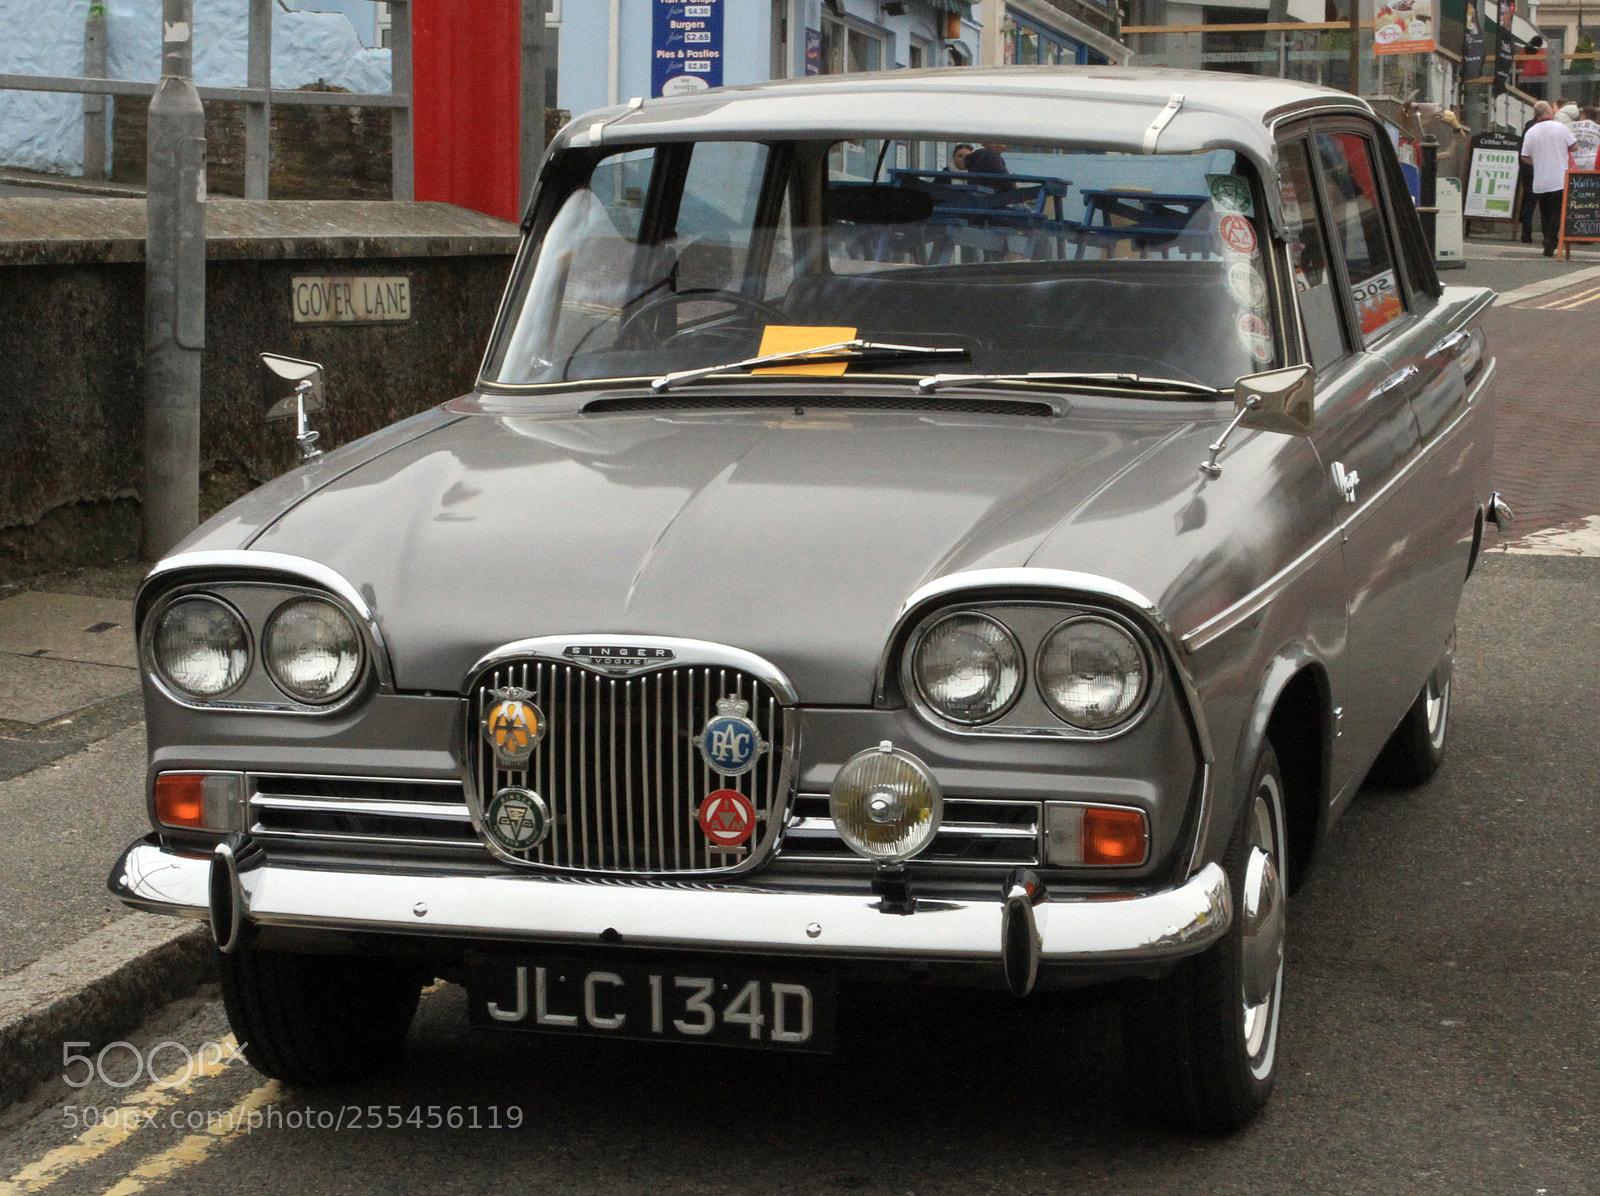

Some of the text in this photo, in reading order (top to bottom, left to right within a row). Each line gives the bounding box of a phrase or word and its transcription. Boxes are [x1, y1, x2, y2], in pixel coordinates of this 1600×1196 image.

[670, 20, 705, 30] Burgers
[656, 49, 720, 58] Pies & Pasties
[1478, 153, 1515, 164] FOOD
[297, 282, 407, 316] GOVER LANE
[571, 647, 667, 657] SINGER
[711, 723, 750, 763] RAC
[487, 966, 814, 1044] JLC 134D
